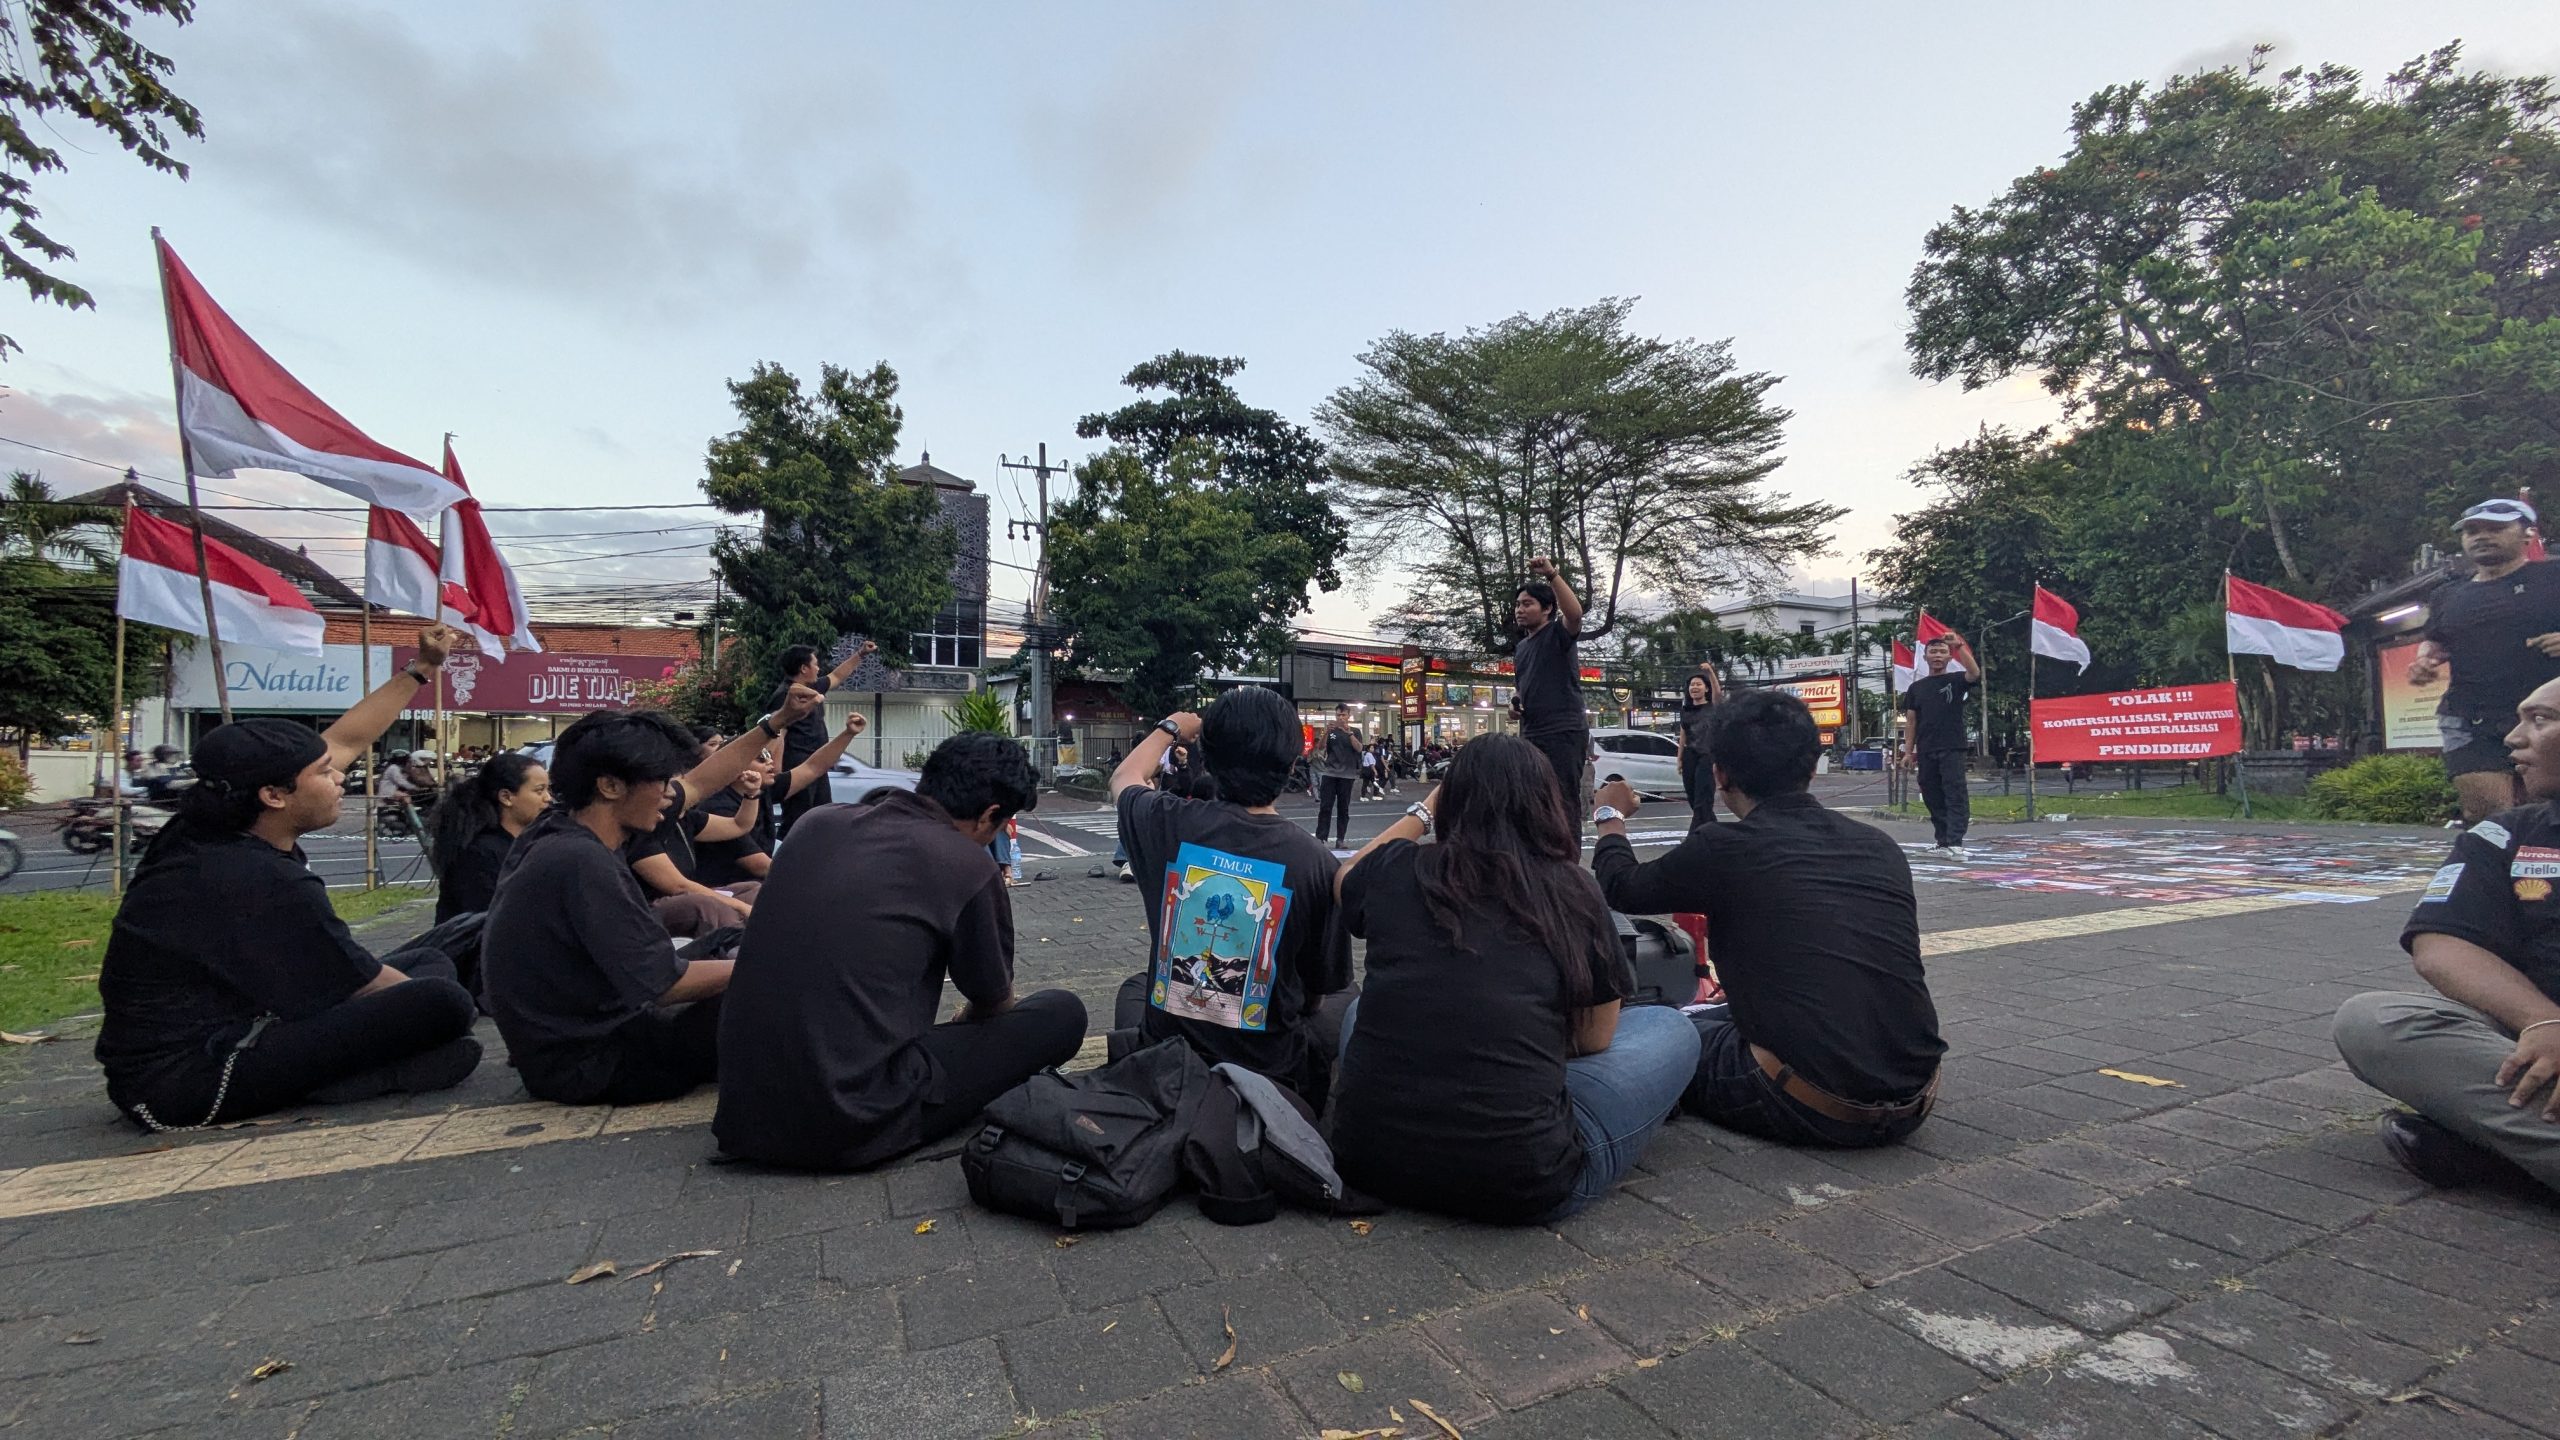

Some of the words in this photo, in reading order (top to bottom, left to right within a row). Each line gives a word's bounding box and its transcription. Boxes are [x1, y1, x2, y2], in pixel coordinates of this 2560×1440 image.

[226, 661, 350, 692] Natalie
[528, 674, 580, 704] DJIE
[2108, 692, 2173, 706] TOLAK
[414, 710, 453, 720] COFEE
[2043, 712, 2172, 728] KOMERSIALISASI,
[2090, 727, 2122, 737] DAN
[2124, 723, 2219, 736] LIBERALISASI
[2099, 743, 2211, 755] PENDIDIKAN
[1211, 855, 1253, 875] TIMUR
[2523, 864, 2558, 875] riello
